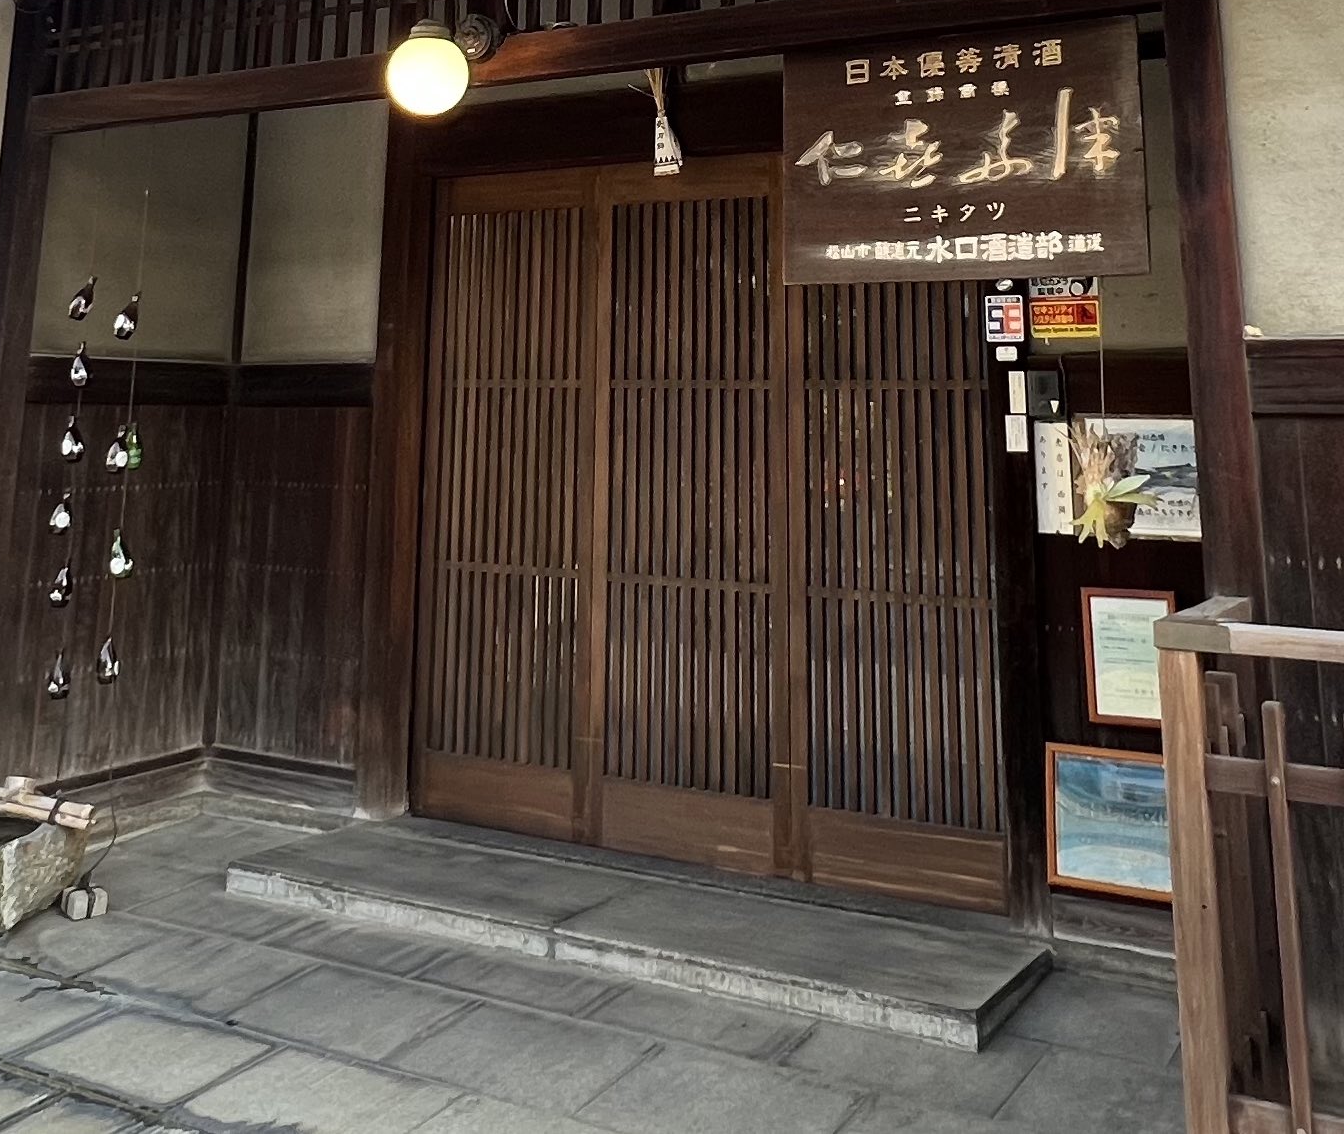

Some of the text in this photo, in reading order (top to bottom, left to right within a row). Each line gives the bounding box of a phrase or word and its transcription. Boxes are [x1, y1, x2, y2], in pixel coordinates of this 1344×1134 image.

[845, 39, 1063, 85] 日本優等清酒
[903, 202, 1005, 223] ニキタツ
